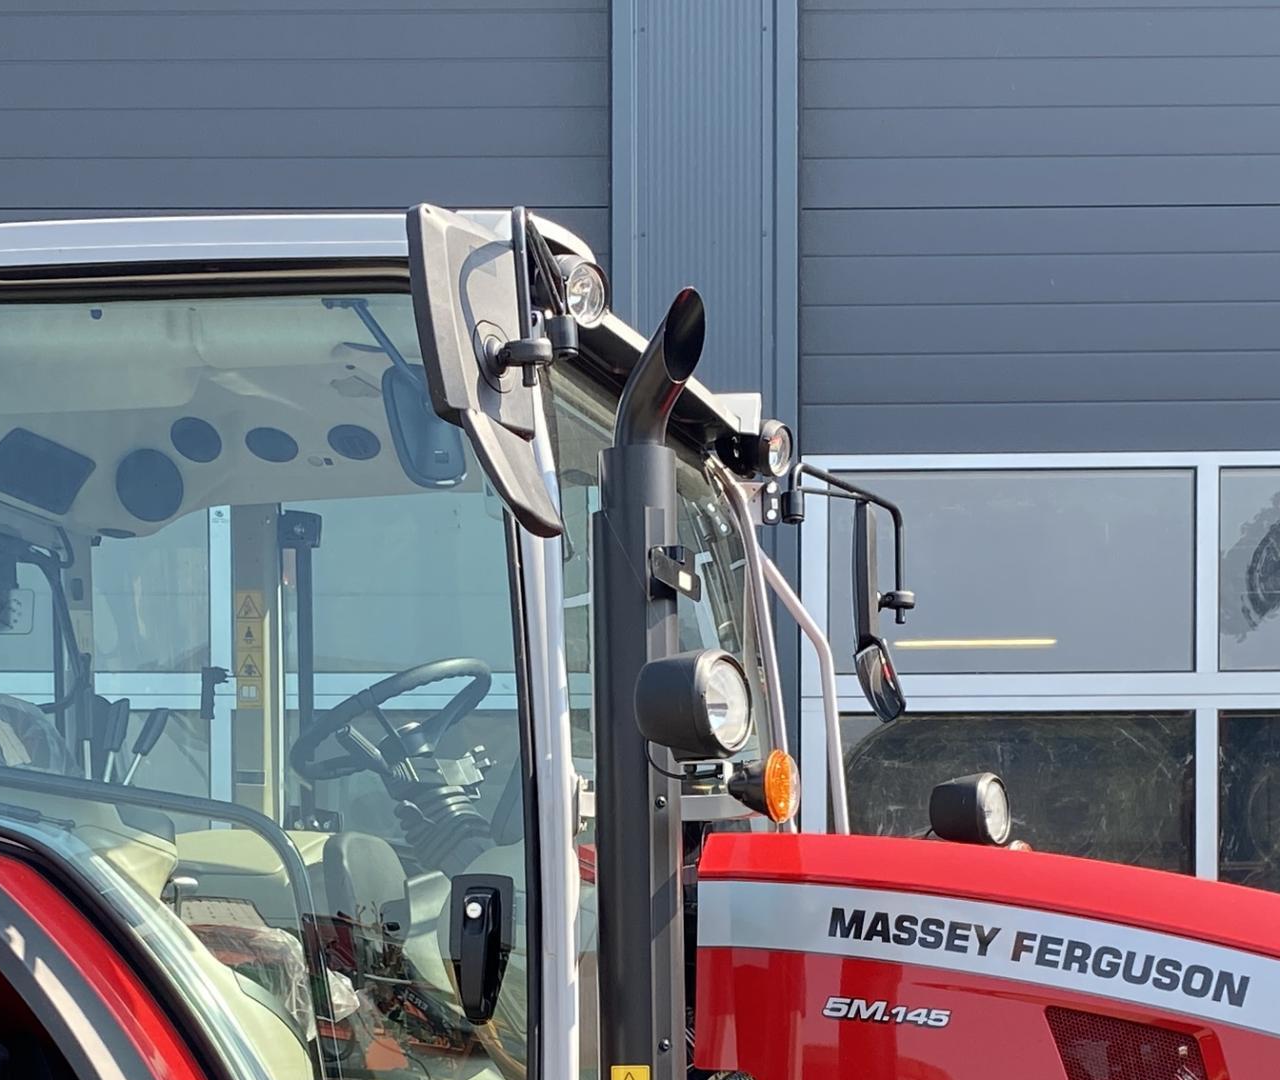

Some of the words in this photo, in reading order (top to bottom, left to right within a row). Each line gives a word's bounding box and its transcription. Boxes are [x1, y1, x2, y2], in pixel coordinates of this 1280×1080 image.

[828, 907, 1001, 956] MASSEY
[1011, 930, 1251, 1008] FERGUSON
[823, 996, 952, 1028] 5M.145
